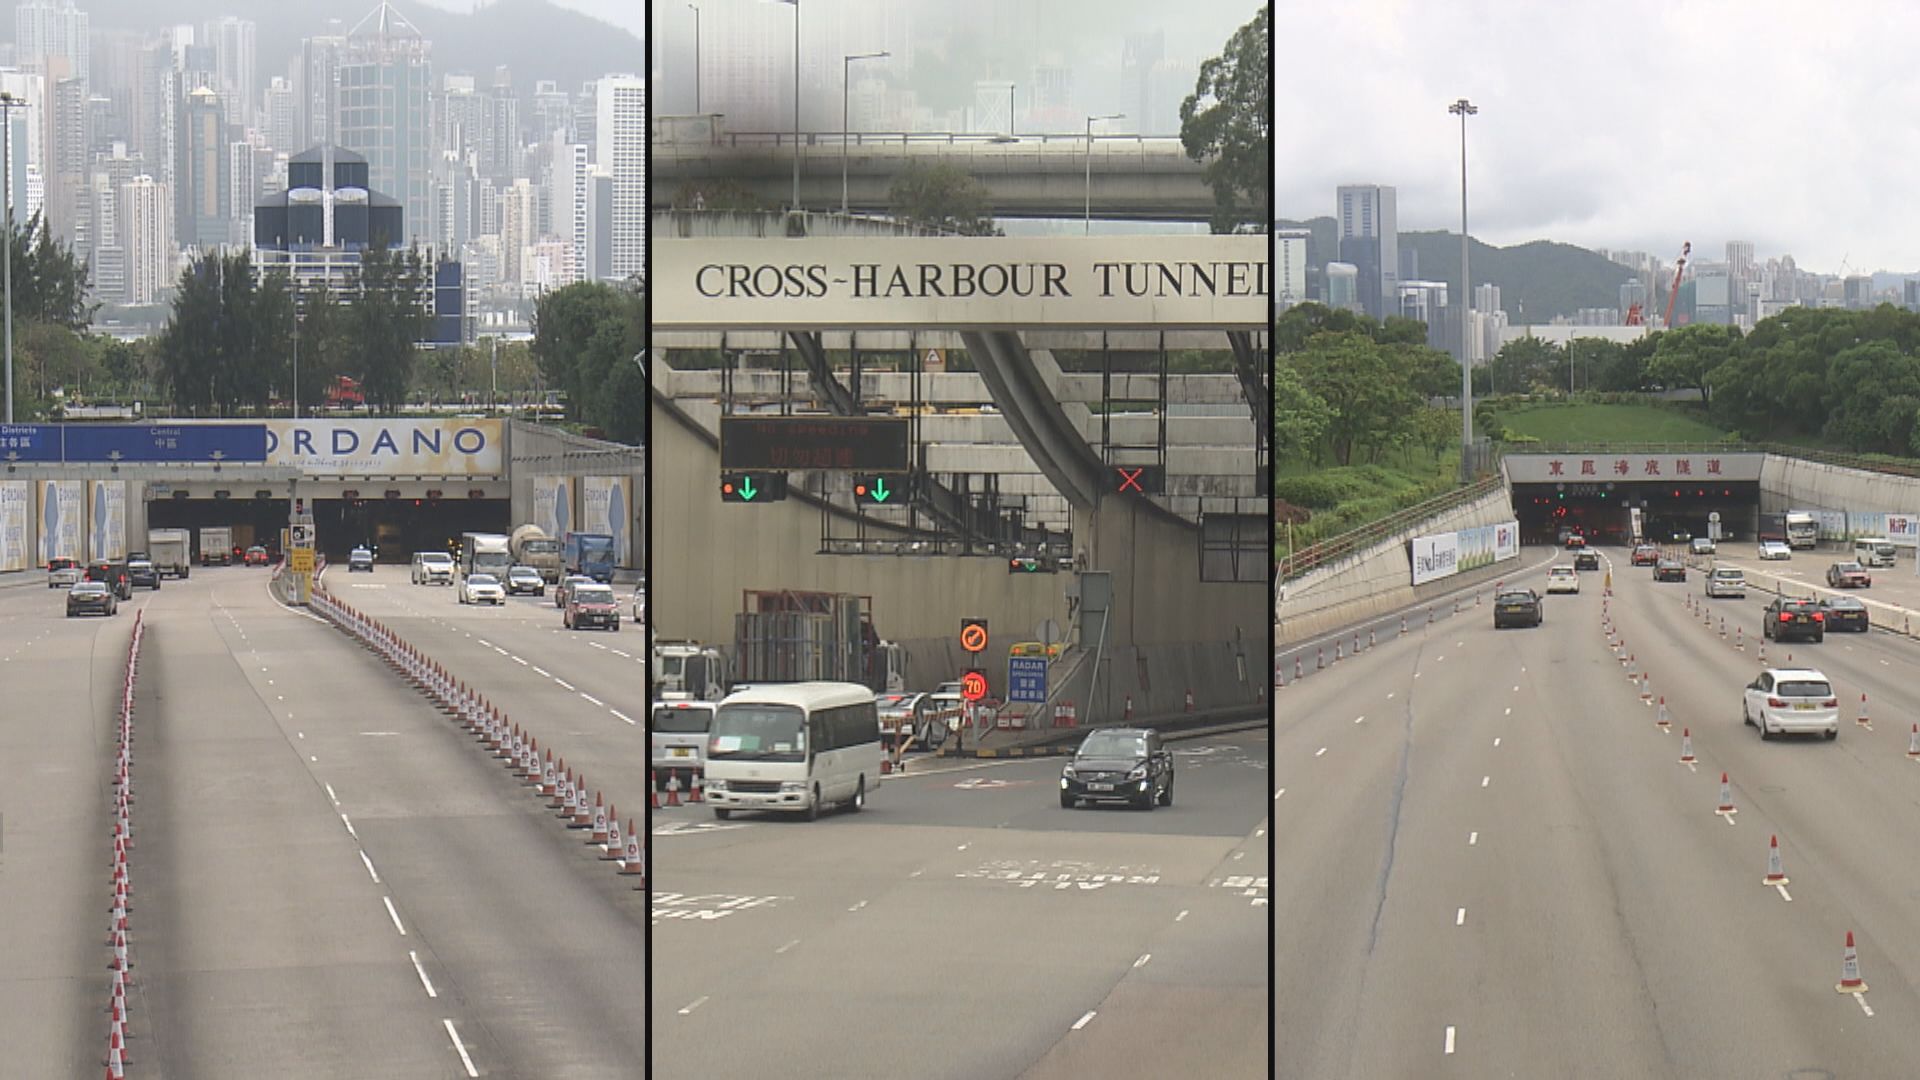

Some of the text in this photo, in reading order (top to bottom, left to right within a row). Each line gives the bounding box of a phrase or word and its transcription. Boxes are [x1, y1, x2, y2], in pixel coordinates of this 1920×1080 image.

[1, 426, 37, 436] Districts
[150, 427, 181, 436] Central
[1548, 459, 1723, 476] 東區海底隧道
[1012, 660, 1044, 671] RADAR
[966, 679, 981, 694] 70
